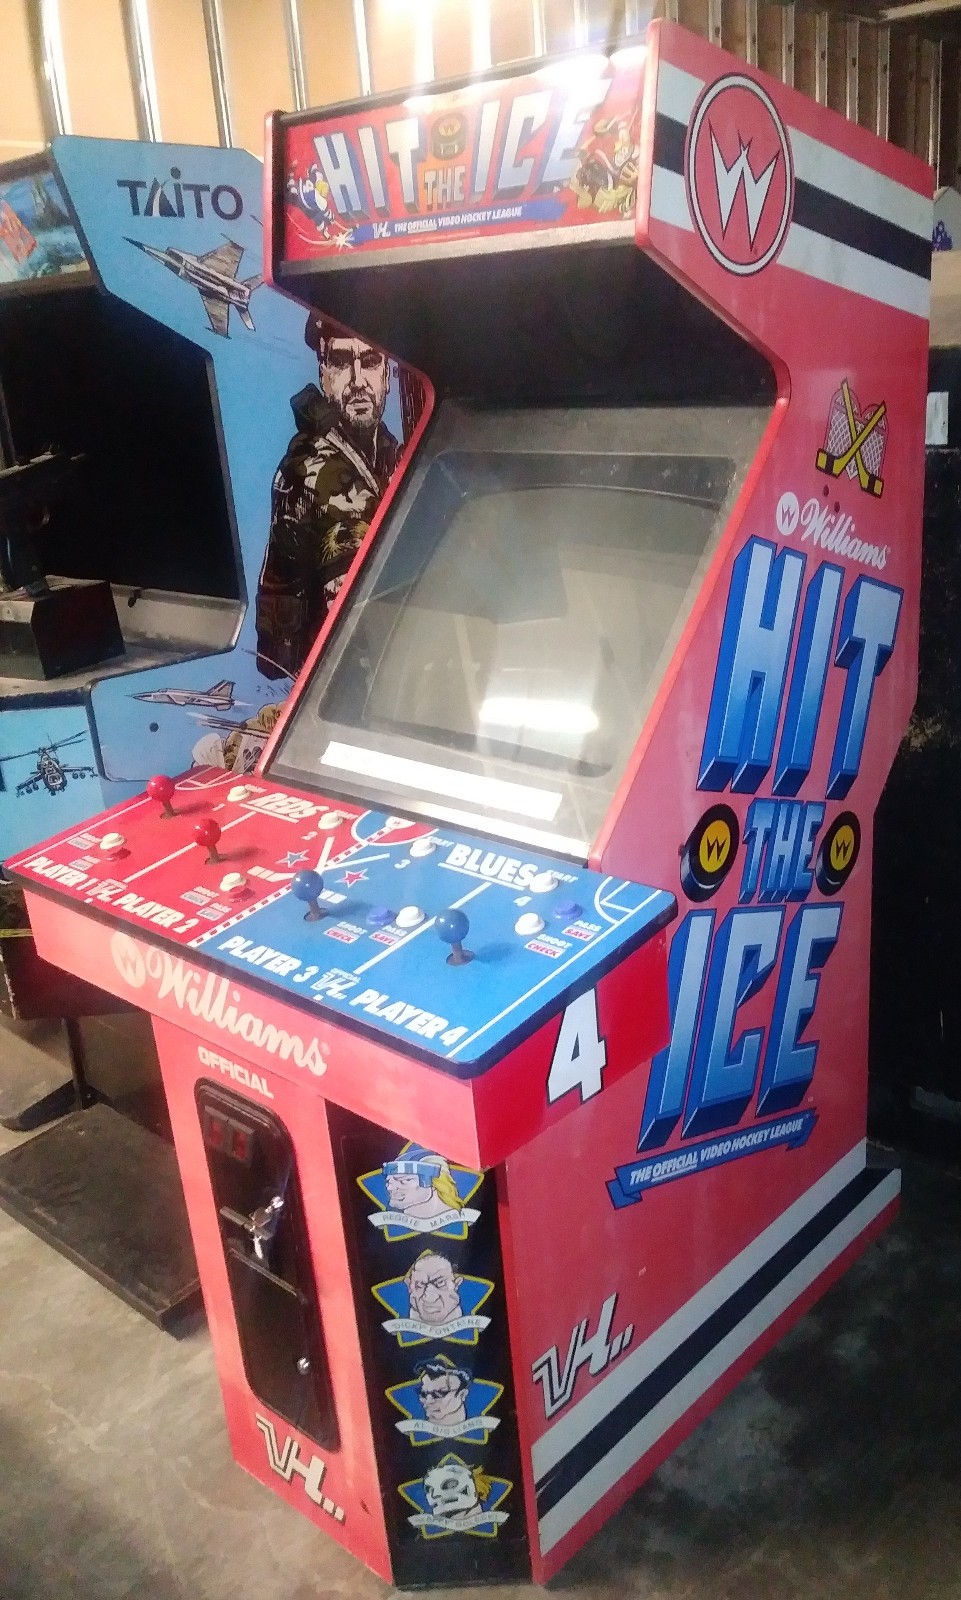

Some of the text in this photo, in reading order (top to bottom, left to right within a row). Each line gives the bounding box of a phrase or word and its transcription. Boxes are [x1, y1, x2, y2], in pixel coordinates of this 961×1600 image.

[313, 78, 612, 219] HIT THE ICE
[117, 166, 243, 220] TAITO
[395, 223, 408, 233] THE
[408, 221, 437, 232] OFFICIAL
[438, 215, 460, 226] VIDEO
[461, 211, 491, 224] HOCKEY
[492, 206, 522, 220] LEAGUE
[800, 498, 888, 570] Williams
[696, 534, 904, 800] HIT
[247, 793, 329, 818] REDS
[24, 857, 88, 887] PLAYER
[76, 878, 99, 890] 1
[446, 844, 538, 886] BLUES
[739, 798, 826, 903] THE
[111, 893, 200, 933] PLAYER 2
[217, 935, 319, 983] PLAYER 3
[528, 943, 560, 956] CHECK
[147, 943, 328, 1076] Williams
[350, 989, 469, 1046] PLAYER 4
[637, 902, 824, 1153] ICE
[198, 1046, 274, 1099] OFFICIAL
[546, 988, 607, 1104] 4
[630, 1119, 804, 1186] THE OFFICIAL VIDEO HOCKEY LEAGUE
[430, 1213, 465, 1228] MARSH
